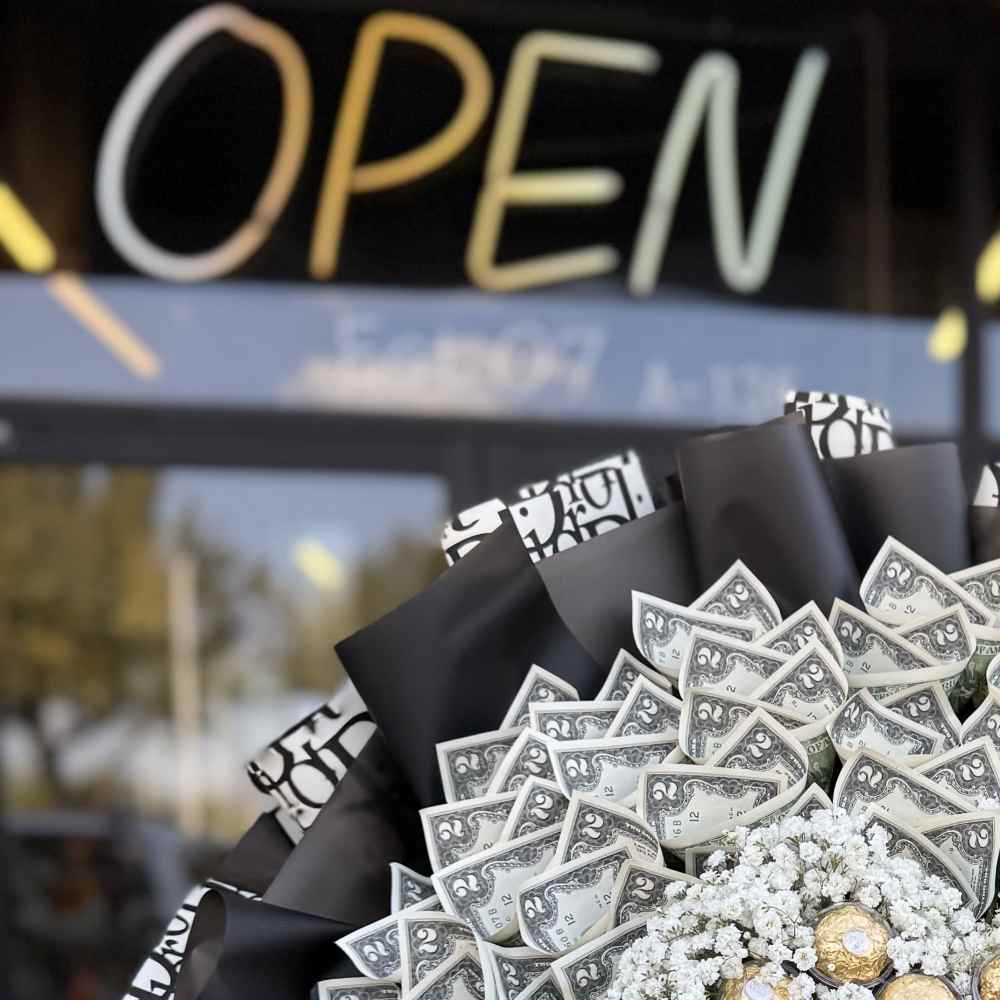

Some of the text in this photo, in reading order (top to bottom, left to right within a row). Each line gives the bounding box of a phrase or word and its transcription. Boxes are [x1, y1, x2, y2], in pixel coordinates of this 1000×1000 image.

[96, 3, 829, 296] OPEN
[886, 561, 910, 585] 2
[934, 624, 958, 645] 2
[698, 647, 721, 668] 2
[800, 664, 823, 689] 2
[638, 700, 658, 723] 2
[700, 702, 722, 722] 2
[750, 733, 771, 757] 2
[456, 753, 481, 774] 2
[566, 759, 587, 778] 2
[963, 759, 984, 780] 2
[858, 766, 883, 784] 2
[653, 781, 677, 800] 2
[532, 793, 554, 819] 2
[440, 819, 464, 840] 2
[581, 814, 603, 838] 2
[453, 874, 478, 897] 2
[631, 878, 654, 898] 2
[524, 896, 546, 917] 2
[364, 941, 386, 961] 2
[416, 928, 437, 953] 2
[577, 963, 600, 987] 2
